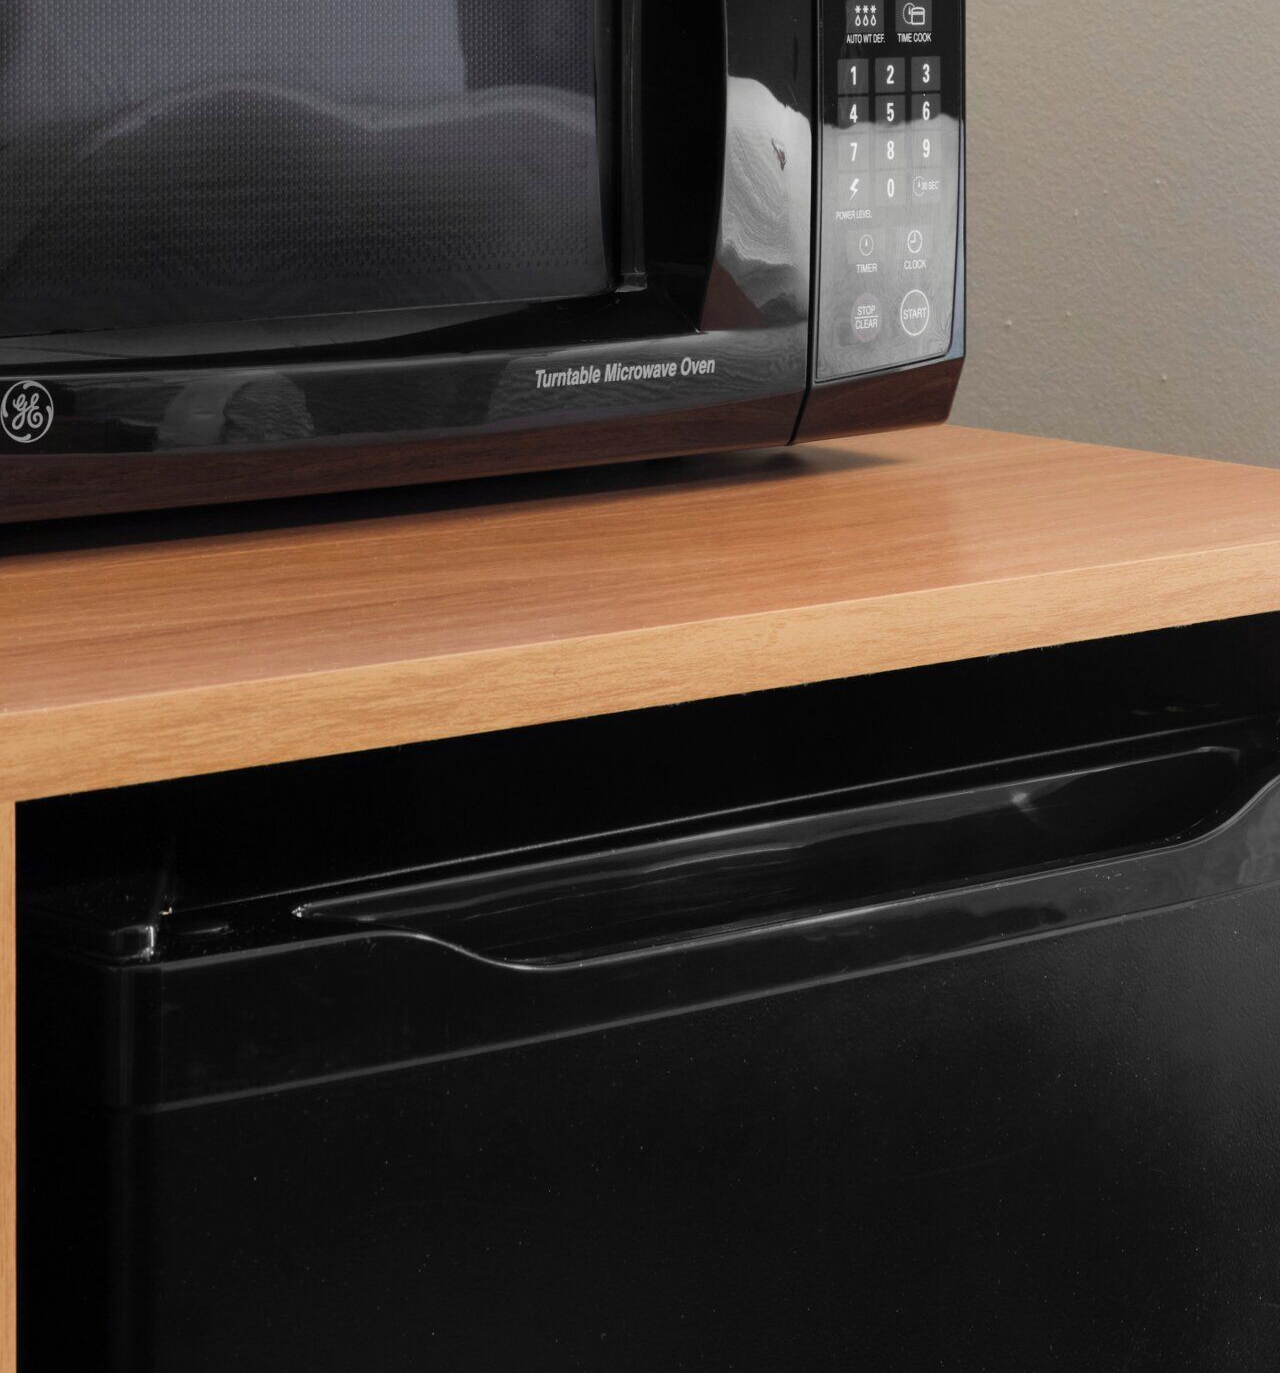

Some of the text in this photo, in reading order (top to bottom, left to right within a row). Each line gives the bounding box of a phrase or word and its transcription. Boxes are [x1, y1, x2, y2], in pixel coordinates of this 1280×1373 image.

[846, 33, 886, 44] AUTO WT DEF.
[897, 32, 932, 43] TIME COOK
[850, 66, 857, 85] 1
[886, 65, 895, 84] 2
[922, 63, 930, 83] 3
[849, 104, 858, 123] 4
[886, 102, 895, 122] 5
[922, 101, 931, 121] 6
[850, 142, 858, 162] 7
[887, 140, 895, 160] 8
[922, 138, 931, 158] 9
[887, 178, 895, 198] 0
[928, 181, 940, 190] SEC
[836, 209, 873, 220] POWER LEVEL
[856, 263, 878, 274] TIMER
[904, 259, 927, 270] CLOCK
[857, 305, 876, 316] STOP
[903, 308, 927, 320] START
[855, 318, 878, 330] CLEAR
[535, 357, 716, 388] Turntable Microwave Oven
